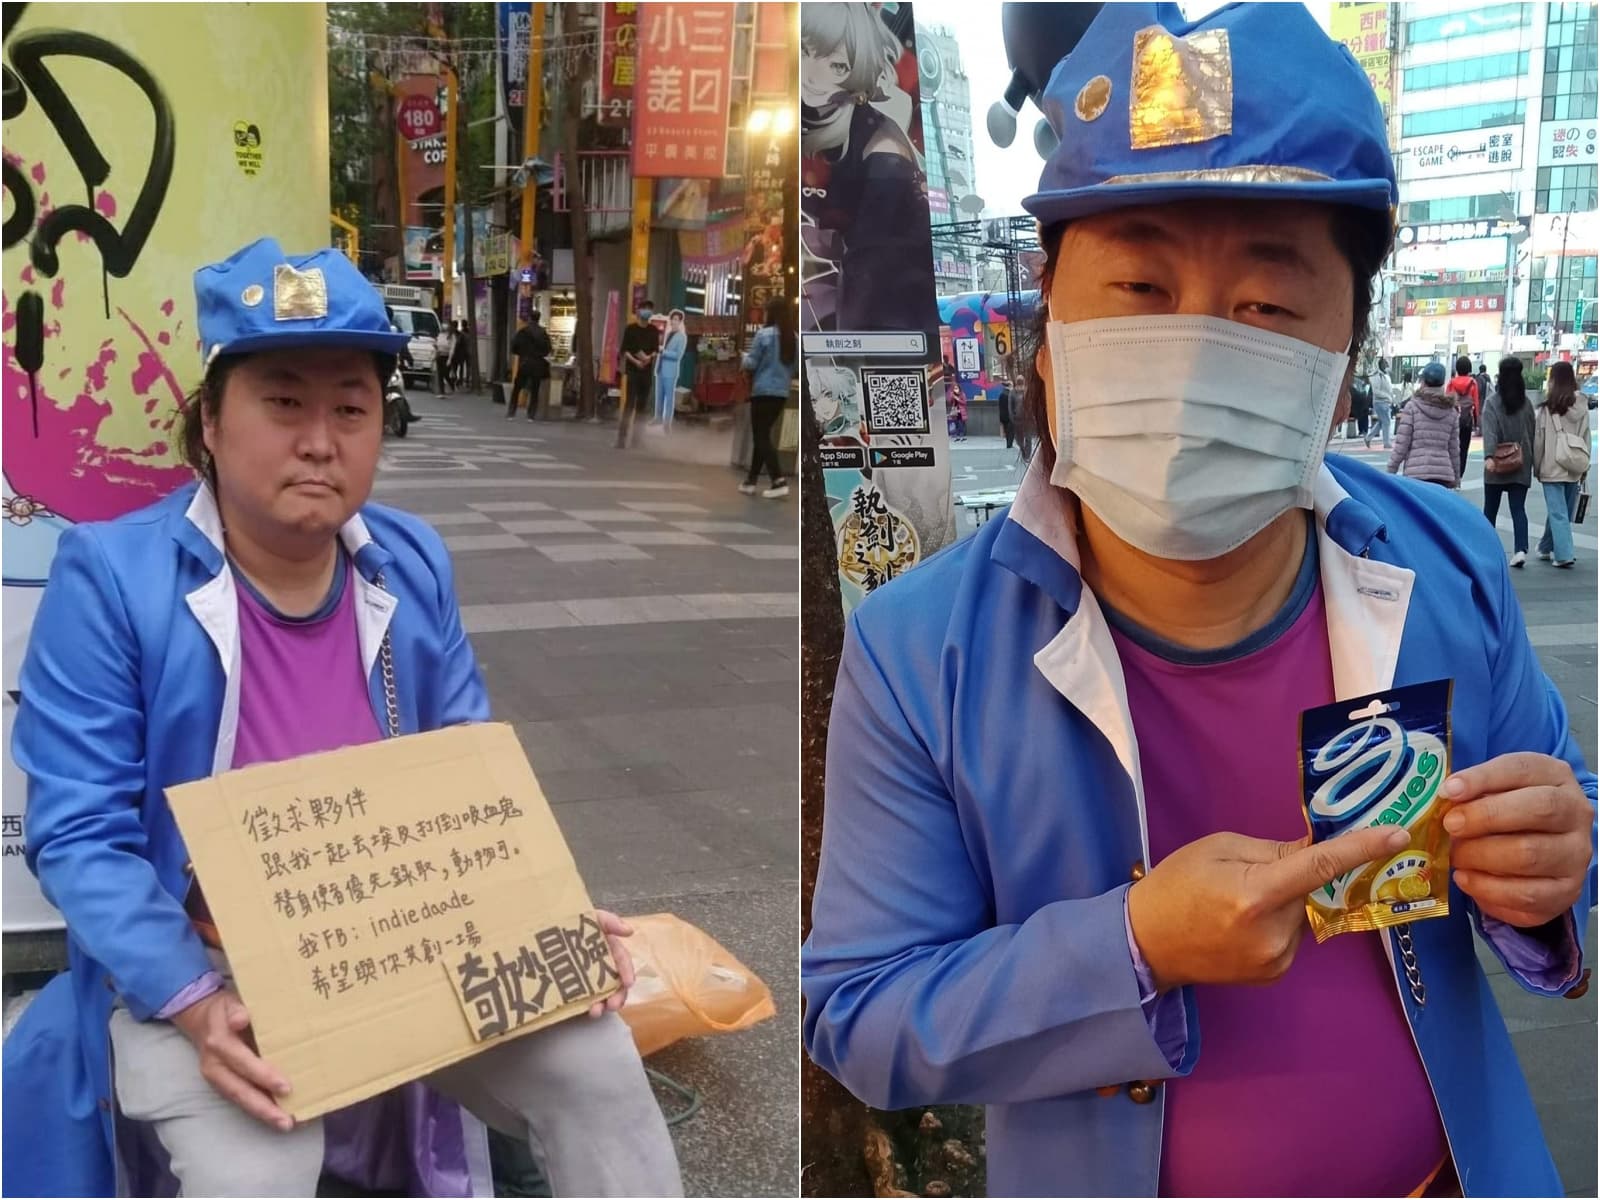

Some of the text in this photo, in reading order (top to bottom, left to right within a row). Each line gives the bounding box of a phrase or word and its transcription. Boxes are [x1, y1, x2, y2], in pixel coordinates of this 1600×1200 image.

[403, 109, 434, 128] 180
[1489, 133, 1513, 148] 密室
[1413, 144, 1444, 157] ESCAPE
[1419, 155, 1444, 167] GAME
[995, 331, 1007, 355] 6
[819, 451, 856, 461] App Store
[890, 450, 928, 461] Google Play
[311, 920, 482, 1000] 希望與你共創一場
